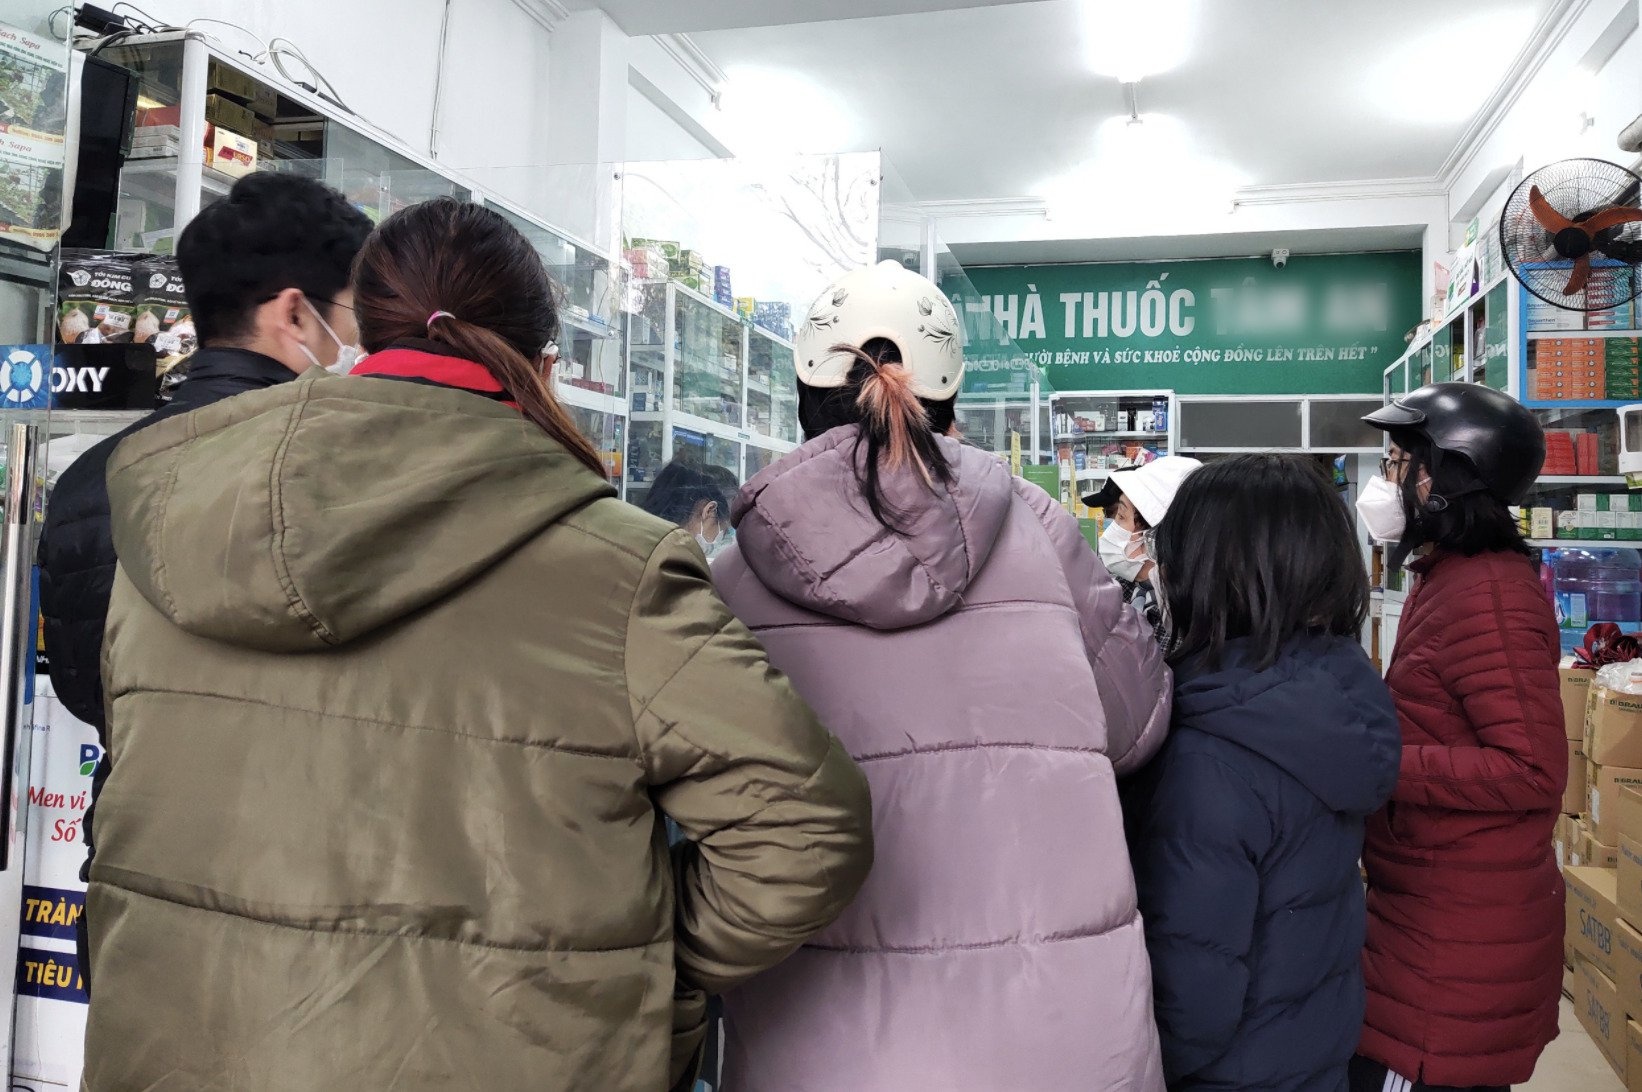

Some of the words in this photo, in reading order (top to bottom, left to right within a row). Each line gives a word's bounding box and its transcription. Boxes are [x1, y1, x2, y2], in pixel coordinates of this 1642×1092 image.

[107, 272, 121, 280] KIM
[1059, 272, 1196, 338] THUỐC
[1055, 348, 1089, 367] BỆNH
[1093, 348, 1111, 364] VÀ
[1114, 347, 1142, 364] SỨC
[1183, 345, 1221, 366] CỘNG
[1223, 342, 1264, 362] ĐỒNG
[1266, 344, 1296, 362] LÊN
[1297, 343, 1334, 362] TRÊN
[1338, 340, 1368, 361] HẾT
[49, 366, 111, 393] OXY
[29, 786, 65, 808] Men
[70, 790, 87, 811] vi
[51, 817, 82, 843] Số
[25, 958, 73, 989] TIÊU
